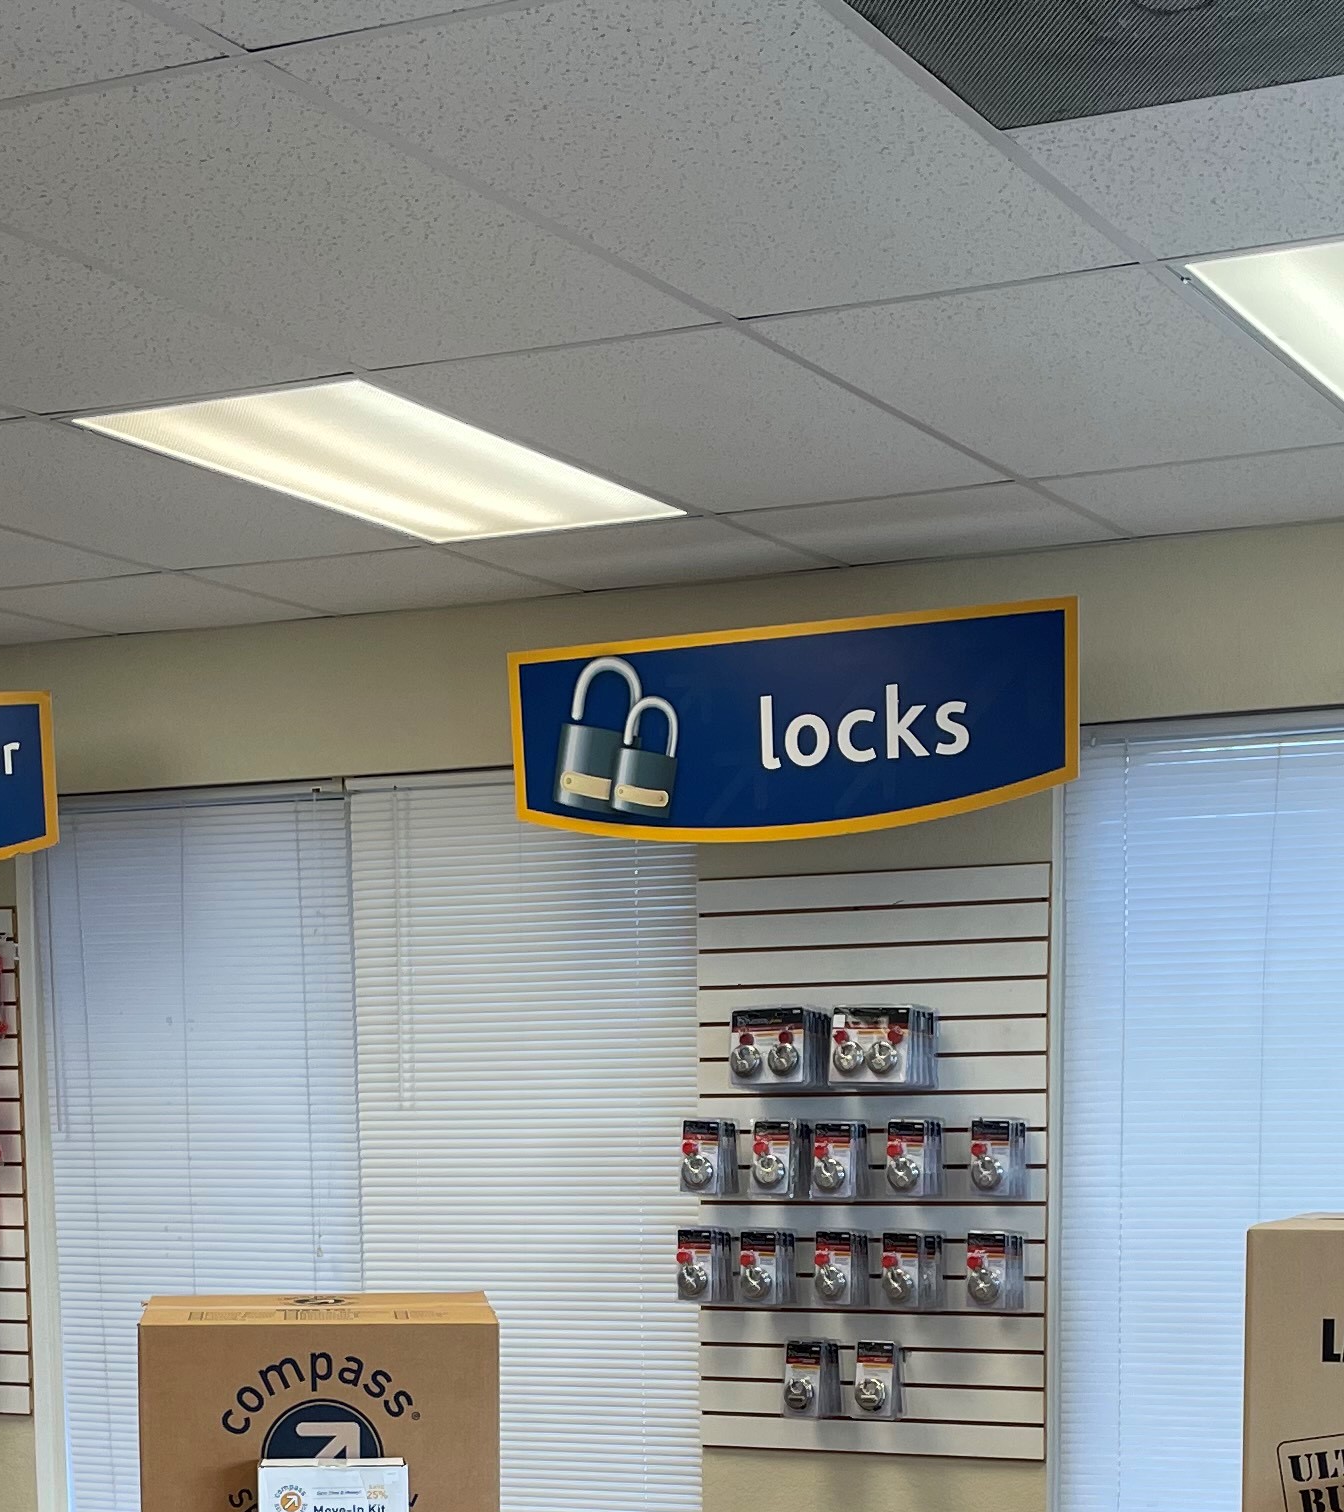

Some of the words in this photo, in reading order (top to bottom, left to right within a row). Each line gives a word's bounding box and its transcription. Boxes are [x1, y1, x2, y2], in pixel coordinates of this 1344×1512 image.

[760, 683, 971, 770] locks
[221, 1351, 414, 1436] compass
[366, 1490, 389, 1500] 25%
